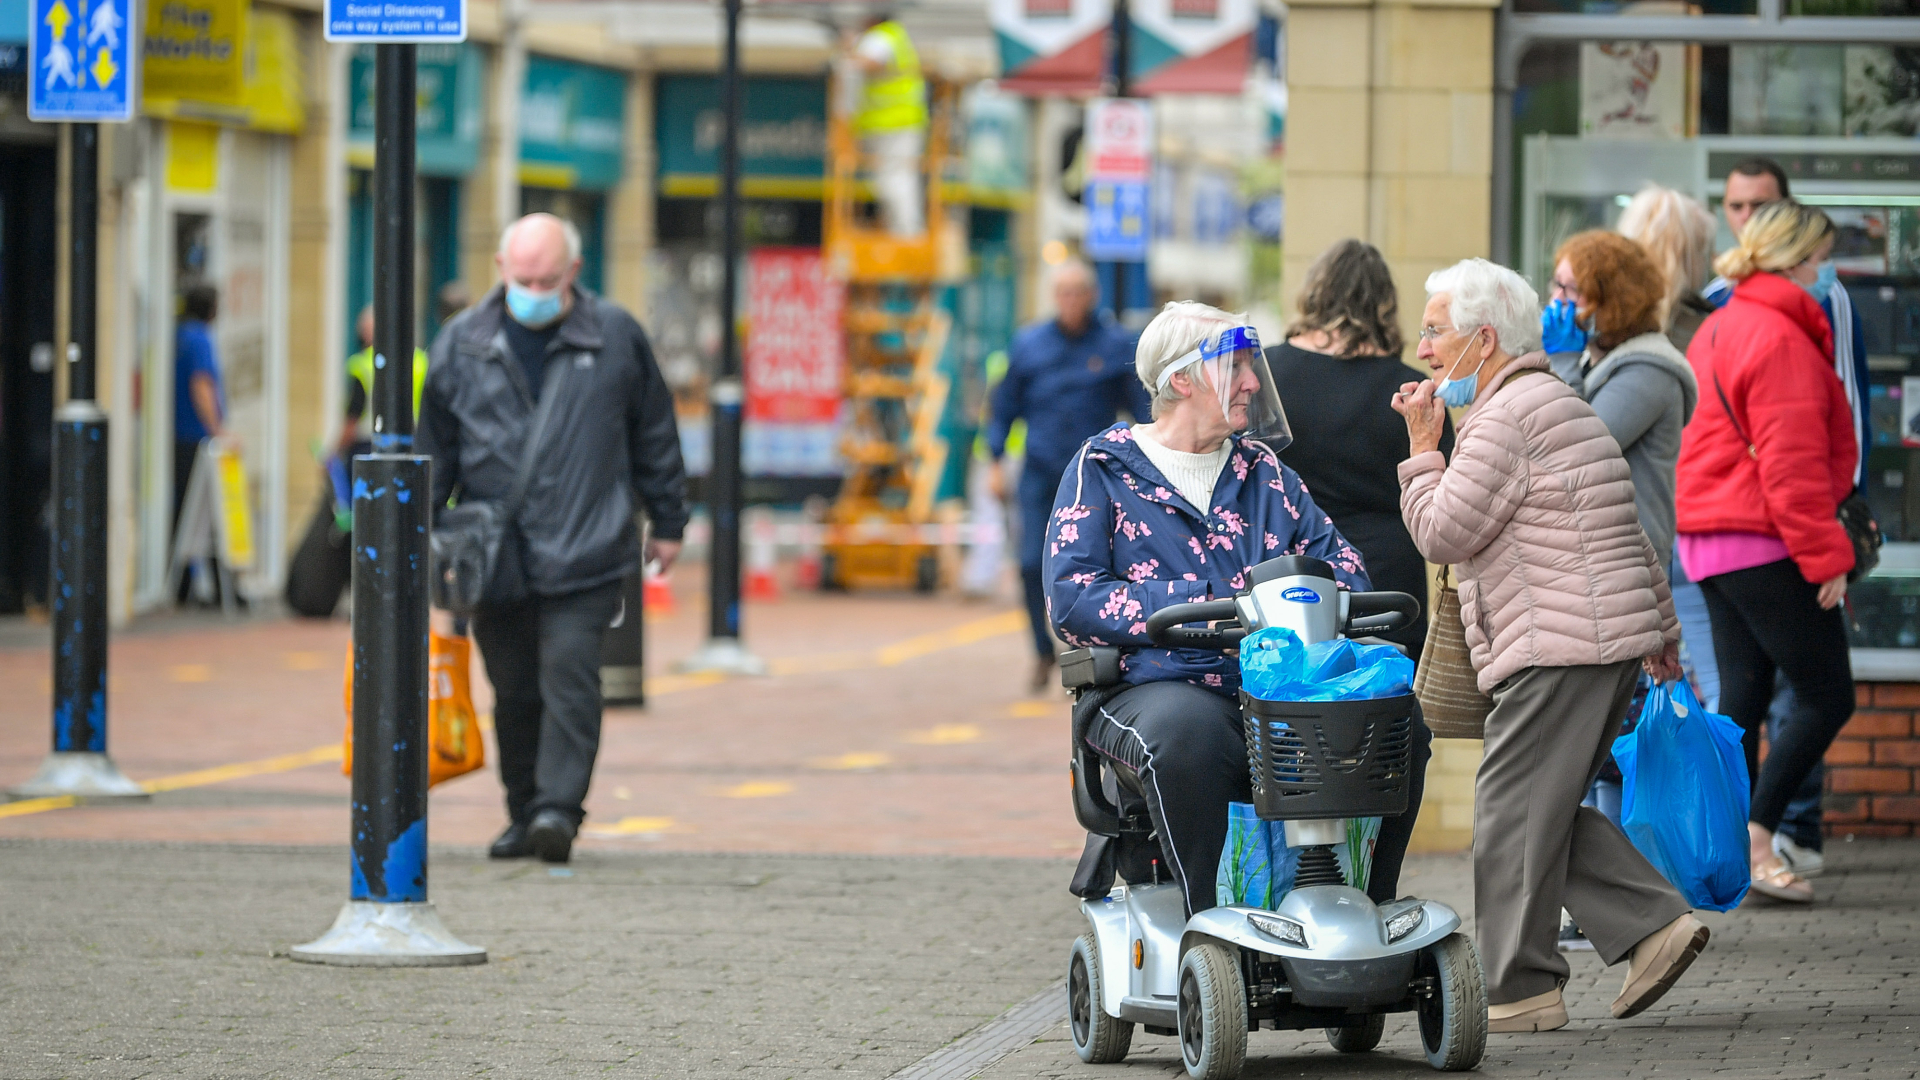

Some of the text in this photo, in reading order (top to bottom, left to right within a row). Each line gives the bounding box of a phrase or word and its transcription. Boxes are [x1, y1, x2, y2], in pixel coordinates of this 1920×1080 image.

[346, 3, 446, 20] Social Distancing
[331, 20, 459, 34] one way system in use
